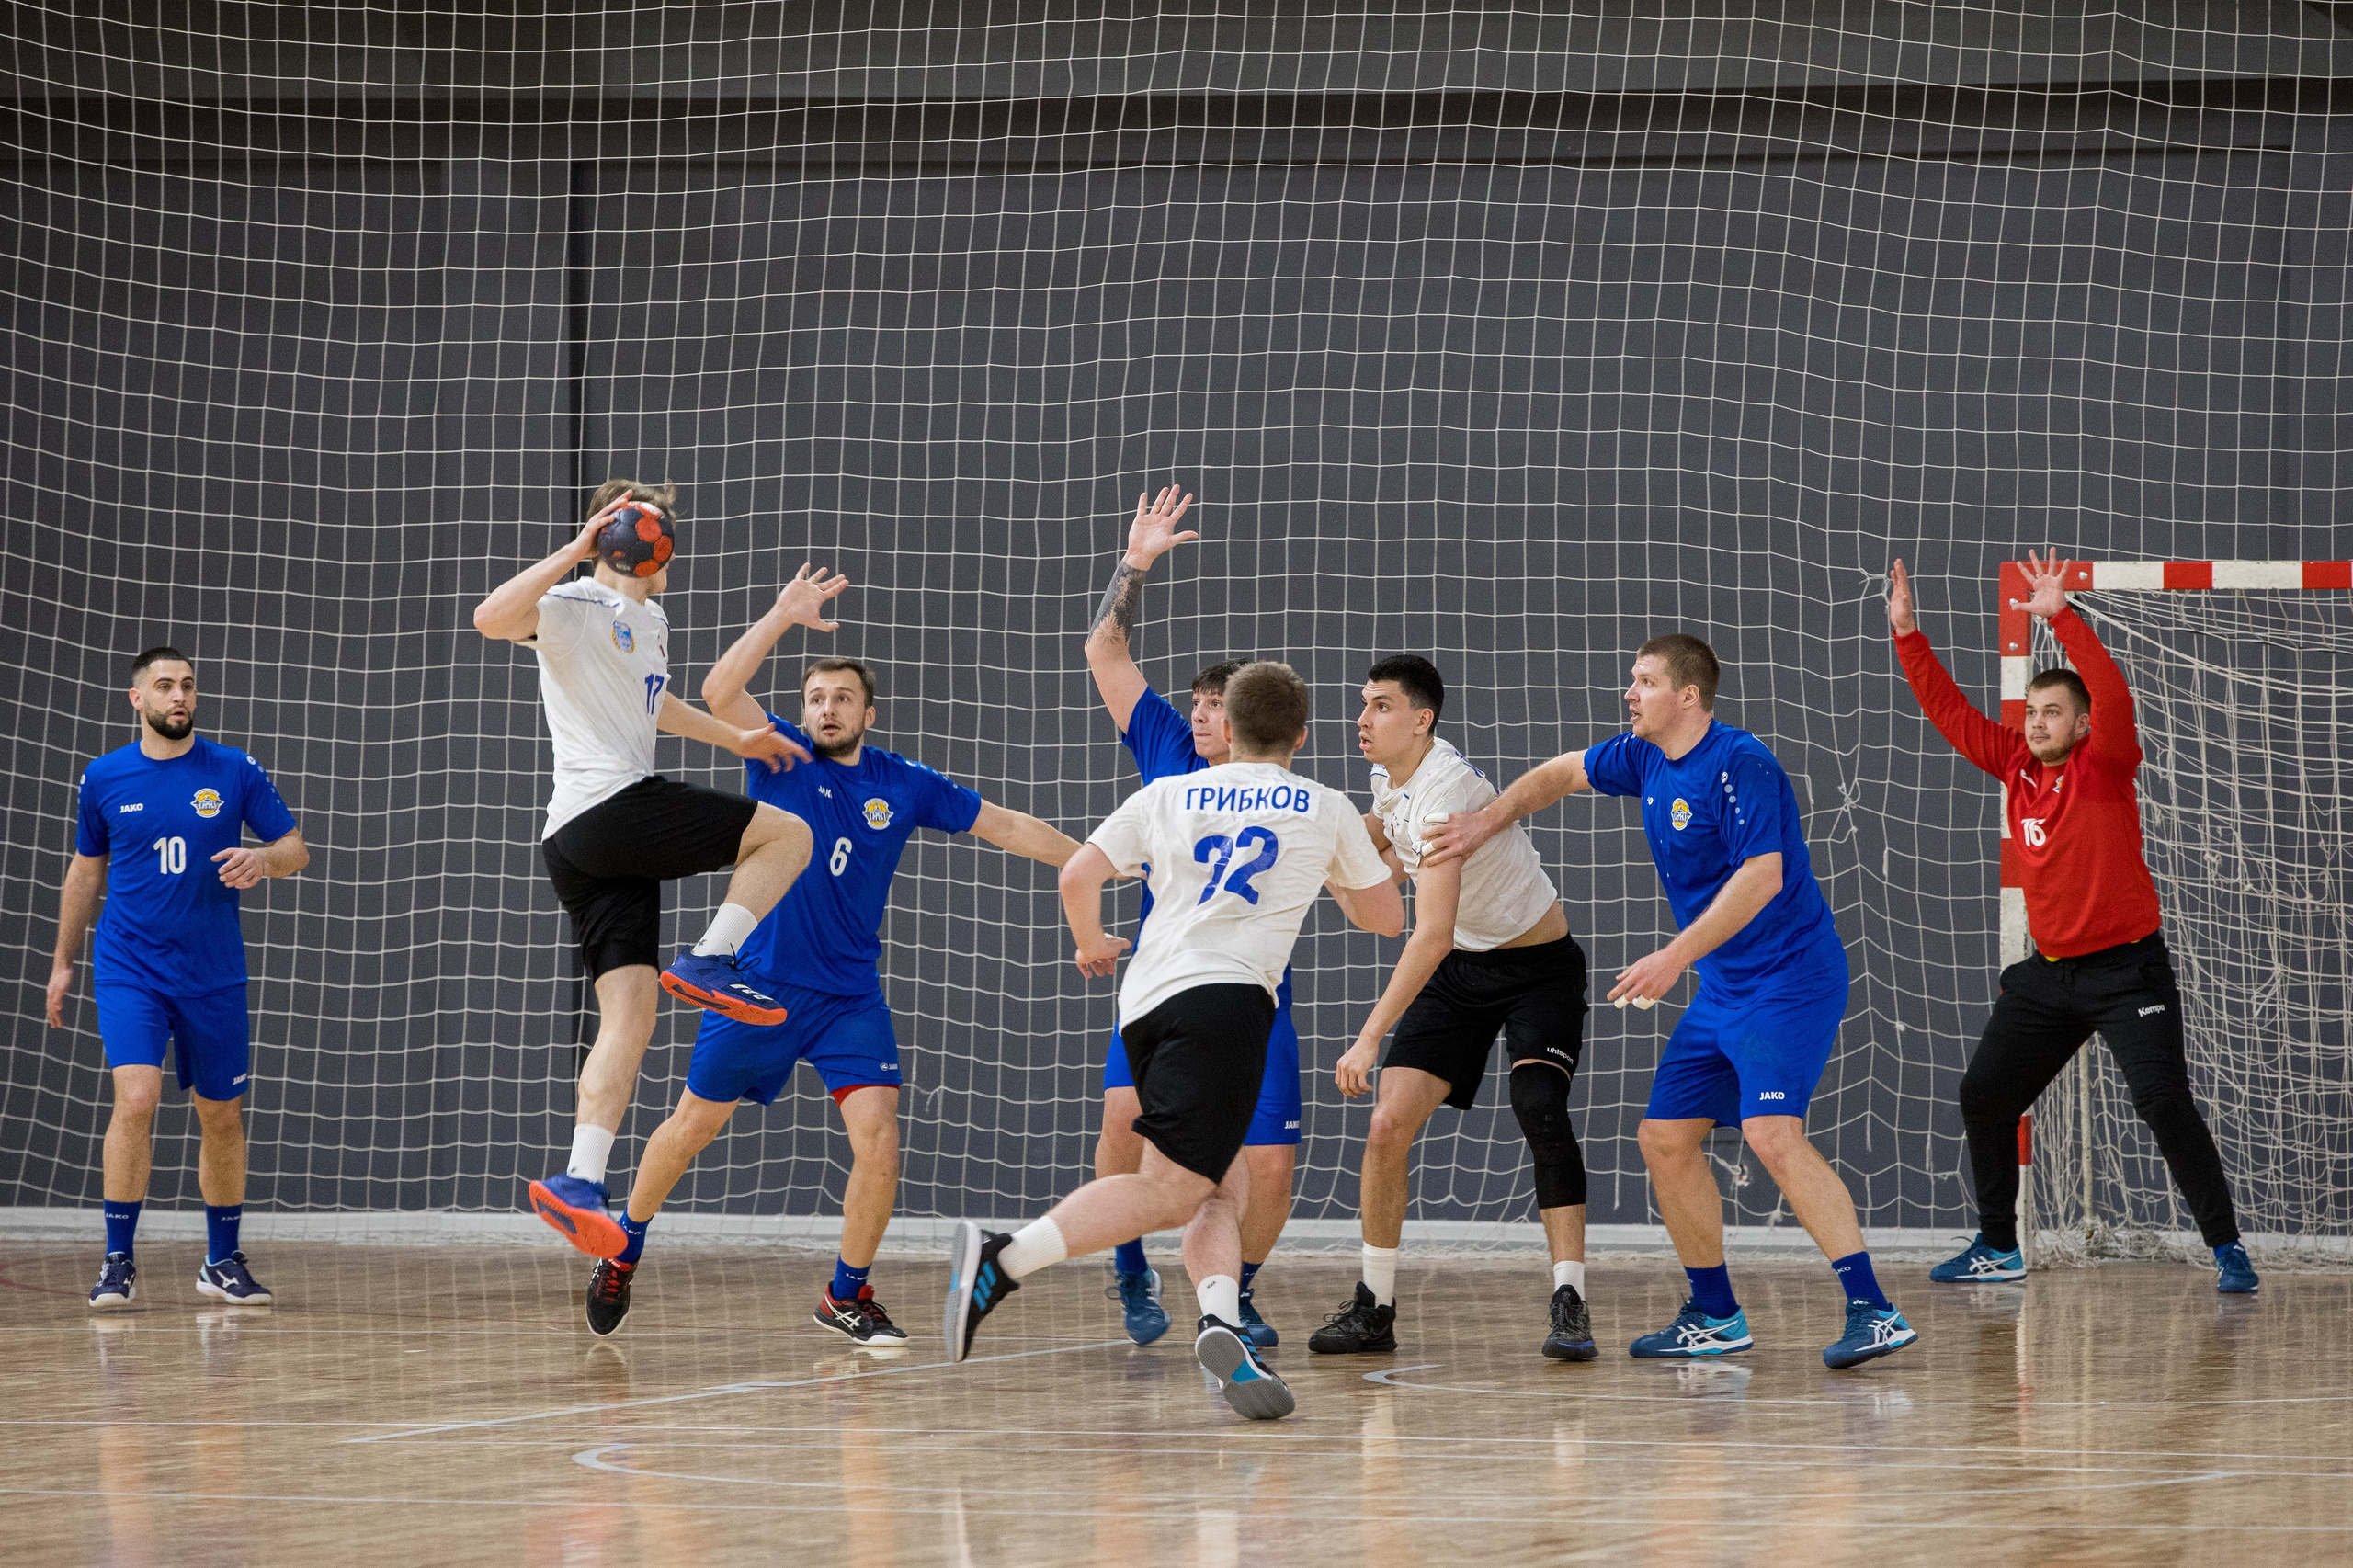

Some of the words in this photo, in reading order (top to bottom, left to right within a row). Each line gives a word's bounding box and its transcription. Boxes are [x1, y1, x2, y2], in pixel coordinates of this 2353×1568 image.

[644, 673, 665, 715] 17
[818, 785, 833, 799] JAK
[1186, 785, 1310, 813] ГРИБКОВ
[119, 802, 144, 813] JAKO
[2020, 818, 2047, 846] 16
[153, 836, 187, 875] 10
[829, 836, 853, 877] 6
[2137, 1004, 2165, 1017] Kempa
[1759, 1091, 1786, 1101] JAKO
